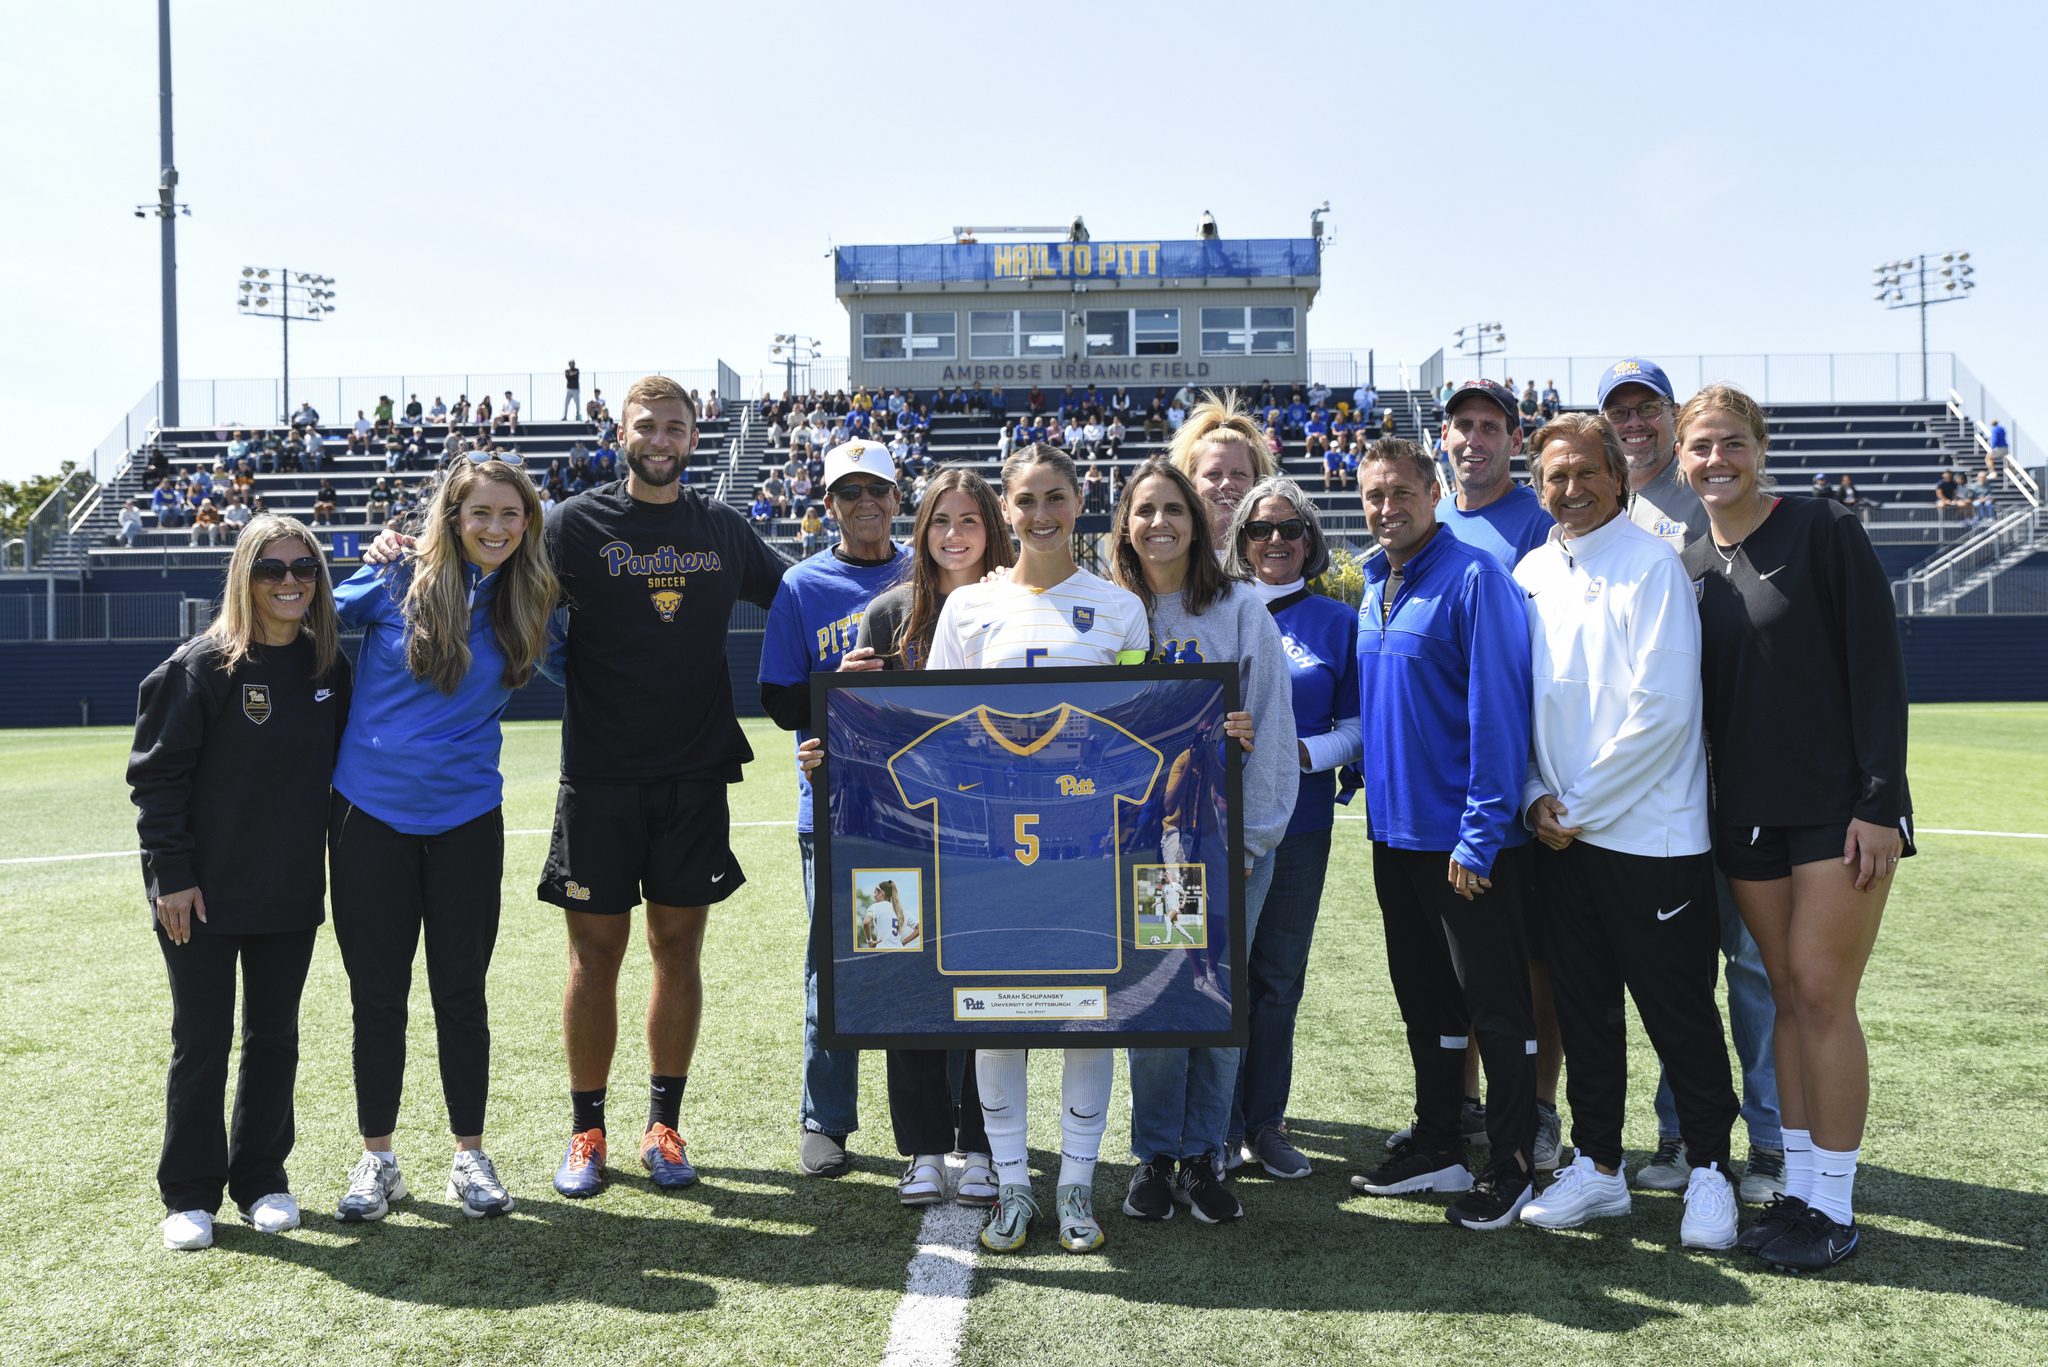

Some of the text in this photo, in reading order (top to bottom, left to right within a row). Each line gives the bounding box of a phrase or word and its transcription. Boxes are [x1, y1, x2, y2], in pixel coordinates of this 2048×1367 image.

[994, 242, 1161, 277] HAIL TO PITT
[942, 362, 1210, 381] AMBROSE URBANIC FIELD
[600, 541, 722, 576] Panthers
[647, 576, 686, 589] SOCCER
[316, 689, 330, 697] NIKE
[1055, 774, 1096, 796] Pitt
[1014, 813, 1039, 867] 5
[565, 880, 590, 900] Pitt
[962, 997, 985, 1010] Pitt
